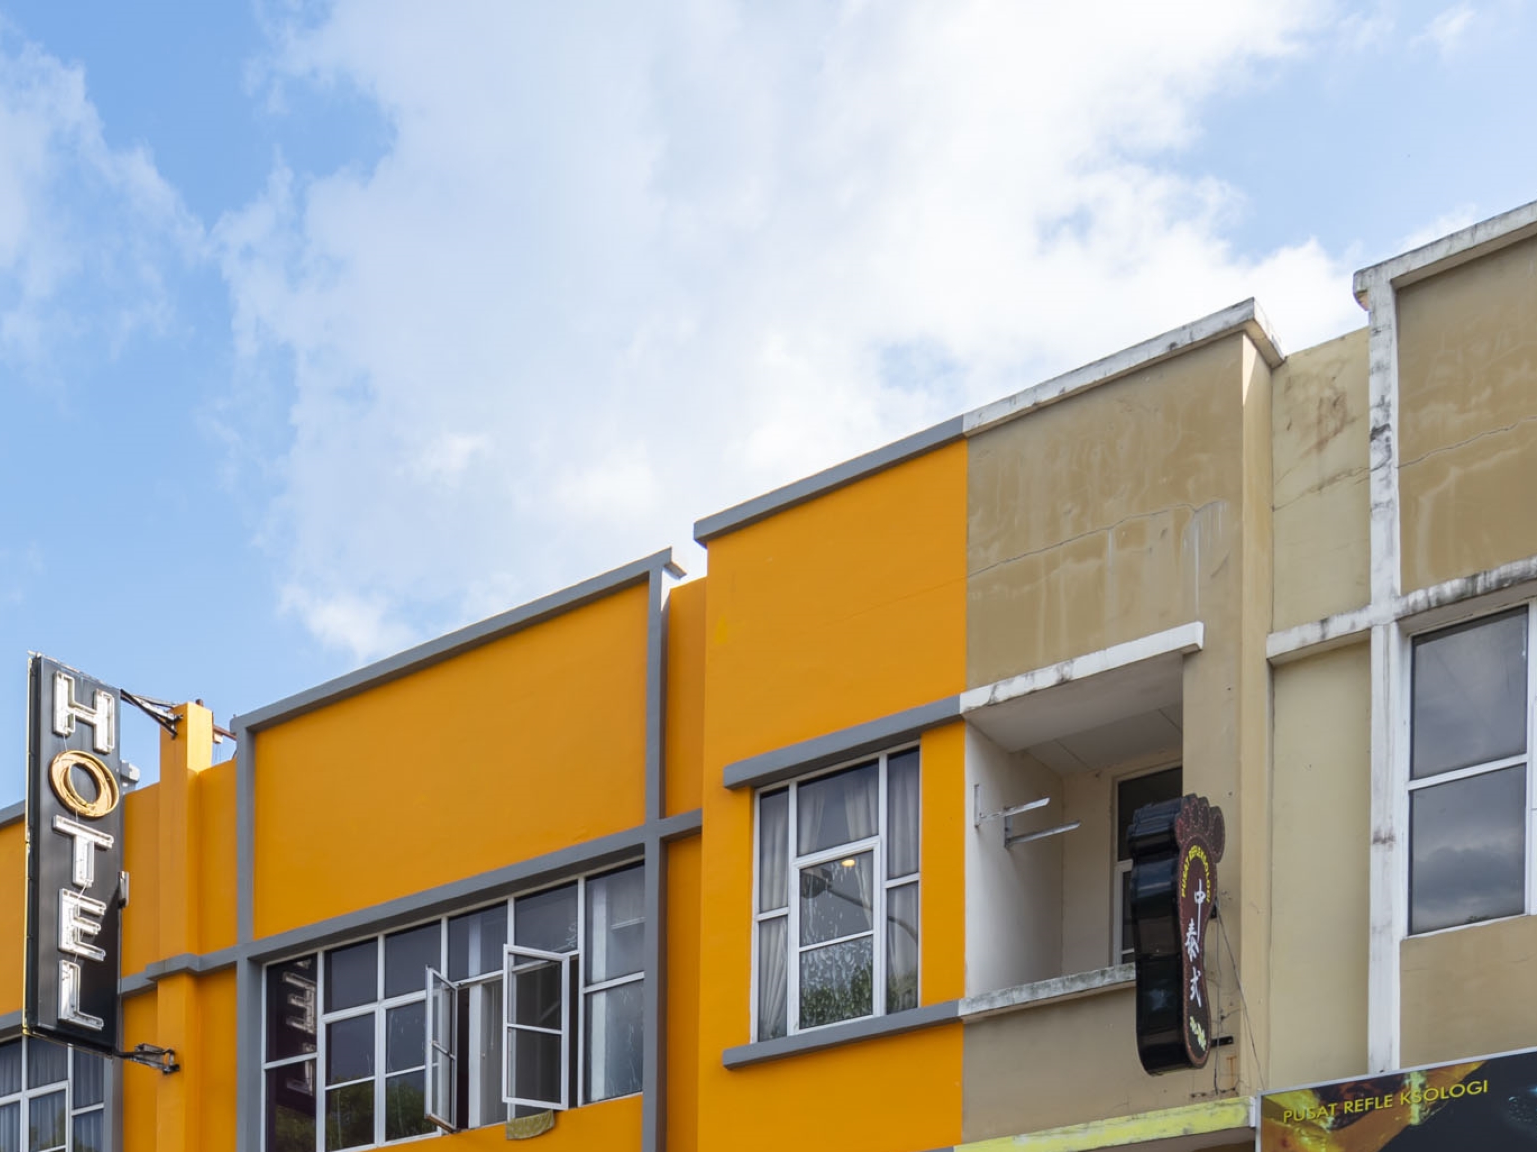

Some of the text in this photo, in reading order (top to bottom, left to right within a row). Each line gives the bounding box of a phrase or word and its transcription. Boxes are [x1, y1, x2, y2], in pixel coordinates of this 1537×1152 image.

[48, 670, 120, 1032] HOTEL
[1283, 1080, 1488, 1123] PUSAT REFLE KSOLOGI
